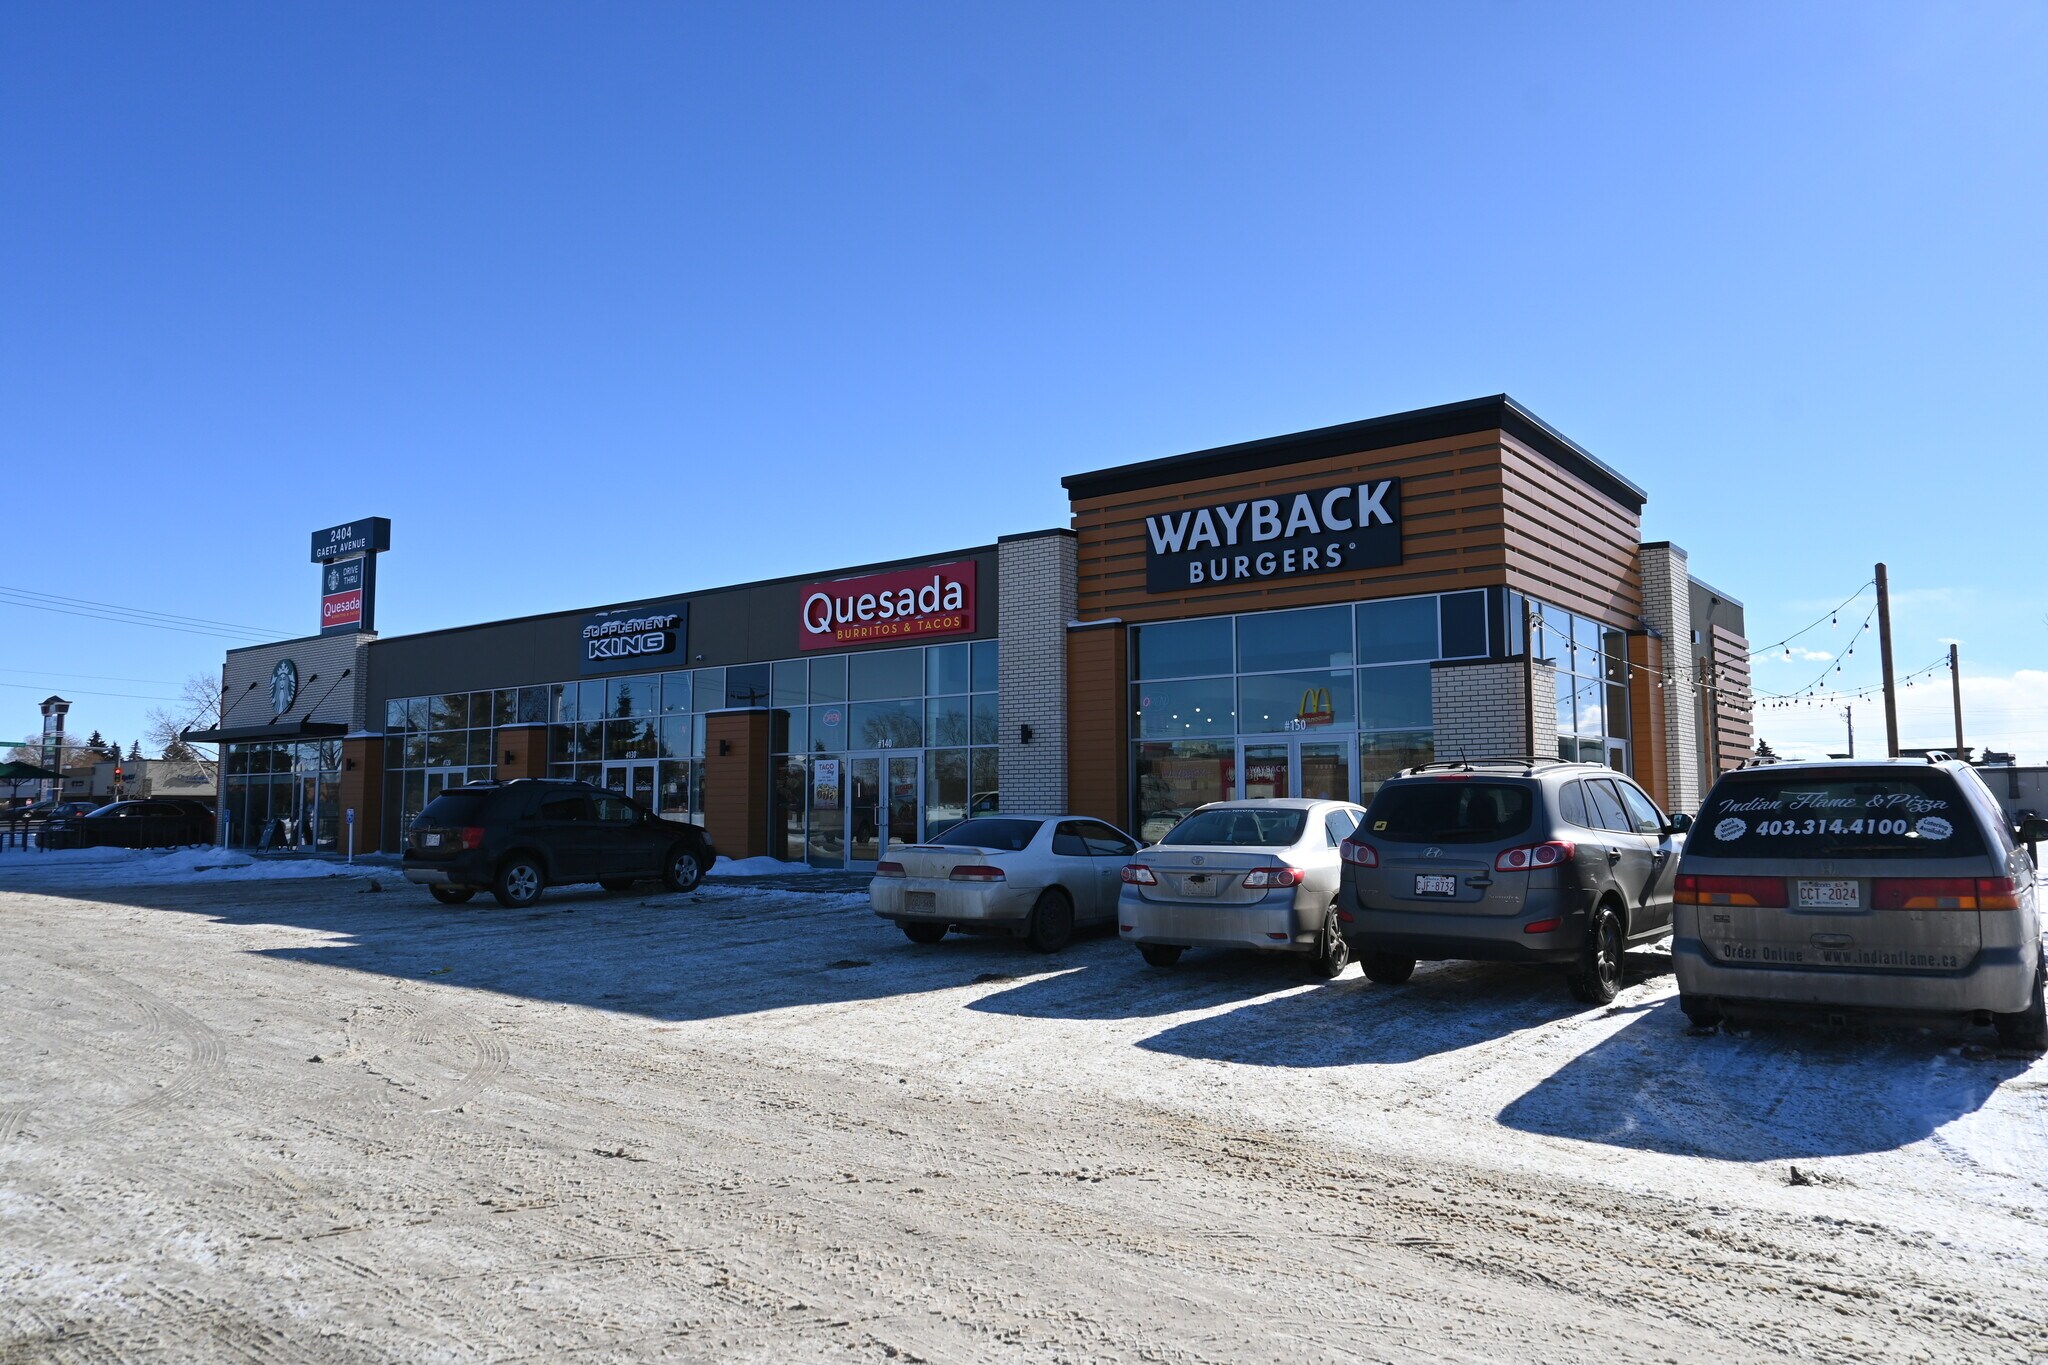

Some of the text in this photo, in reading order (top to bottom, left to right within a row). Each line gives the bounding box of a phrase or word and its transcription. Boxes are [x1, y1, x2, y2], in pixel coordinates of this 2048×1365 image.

[1146, 481, 1393, 555] WAYBACK
[331, 526, 352, 542] 2404
[317, 538, 365, 557] GAETZ AVENUE
[343, 565, 359, 576] DRIVE
[1189, 543, 1342, 584] BURGERS
[344, 574, 358, 585] THRU
[324, 597, 360, 617] Quesada
[803, 575, 963, 634] Quesada
[583, 617, 673, 638] SUPPLEMENT
[837, 616, 960, 640] BURRITOS & TACOS
[588, 632, 665, 659] KING
[1284, 718, 1306, 731] #150
[878, 739, 893, 748] #140
[1719, 793, 1949, 814] Indian Flame & Pizza
[1756, 819, 1907, 836] 403.314.4100
[1416, 880, 1455, 892] CJF-8732
[1800, 887, 1857, 900] CCT-2024
[1724, 944, 1958, 968] Order Online www.indianflame.ca
